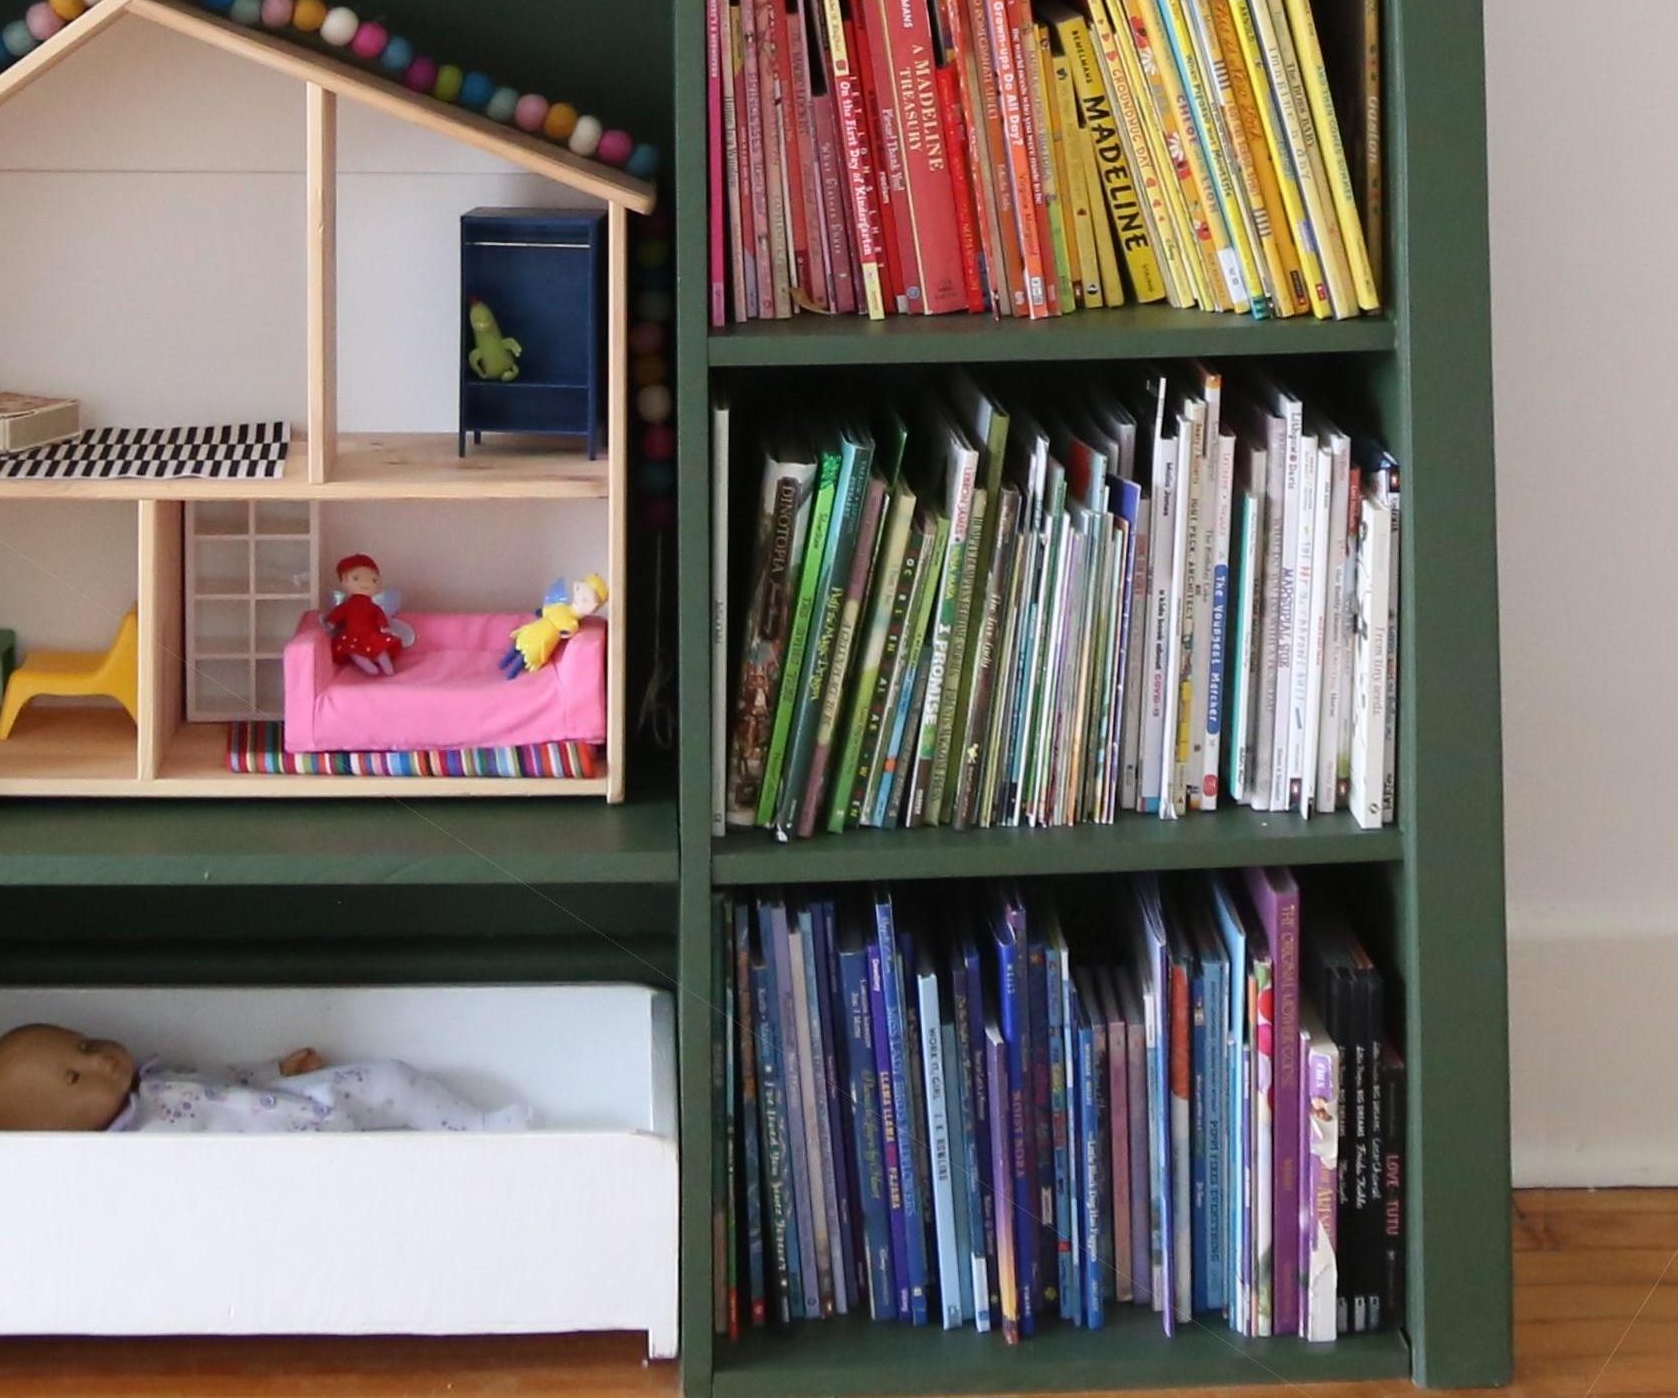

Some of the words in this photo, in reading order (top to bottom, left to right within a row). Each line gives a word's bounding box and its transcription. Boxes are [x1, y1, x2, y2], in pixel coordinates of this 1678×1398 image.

[973, 7, 995, 83] POMEGRANATE
[990, 0, 1013, 70] Grown-ups
[1014, 42, 1025, 69] world
[1070, 28, 1093, 85] BEMELMANS
[842, 98, 855, 117] the
[897, 66, 923, 154] TREASURY
[911, 58, 947, 172] MADELINE
[1006, 92, 1018, 110] All
[1109, 67, 1143, 143] GROUNDHUG
[1134, 144, 1152, 170] DAY
[1286, 62, 1298, 81] The
[1300, 116, 1316, 149] BABY
[844, 119, 858, 146] First
[1006, 113, 1024, 147] Day?
[1365, 95, 1380, 164] Gaston
[847, 148, 861, 170] Day
[1175, 93, 1199, 147] CHLOE
[1199, 174, 1219, 214] LION
[1081, 92, 1148, 252] MADELINE
[852, 184, 874, 256] Kindergarten
[1287, 411, 1301, 452] Lithgow
[958, 465, 973, 503] LEBRON
[1287, 463, 1297, 490] Davis
[952, 503, 968, 536] JAMES
[1162, 488, 1172, 517] Jones
[771, 484, 794, 575] DINOTOPIA
[944, 572, 957, 600] MATA
[1183, 560, 1195, 620] ARCHITECT
[1215, 575, 1225, 596] The
[1279, 567, 1294, 639] MARSUPIAL
[1157, 597, 1166, 617] kids
[1210, 604, 1223, 664] Youngest
[1153, 641, 1163, 671] about
[1277, 642, 1290, 669] SUE
[923, 639, 948, 726] PROMISE
[1208, 671, 1220, 723] Marcher
[1281, 904, 1294, 926] THE
[927, 1028, 937, 1059] WORK
[880, 1071, 892, 1106] LLAMA
[931, 1076, 941, 1101] GIRL
[882, 1106, 895, 1143] LLAMA
[1208, 1120, 1218, 1150] PIPPI
[1355, 1104, 1365, 1137] DREAMS
[1354, 1143, 1365, 1175] Frida
[1385, 1154, 1399, 1188] LOVE
[887, 1166, 902, 1209] PAJAMA
[1355, 1175, 1366, 1210] Kahlo
[1385, 1199, 1399, 1235] TUTU
